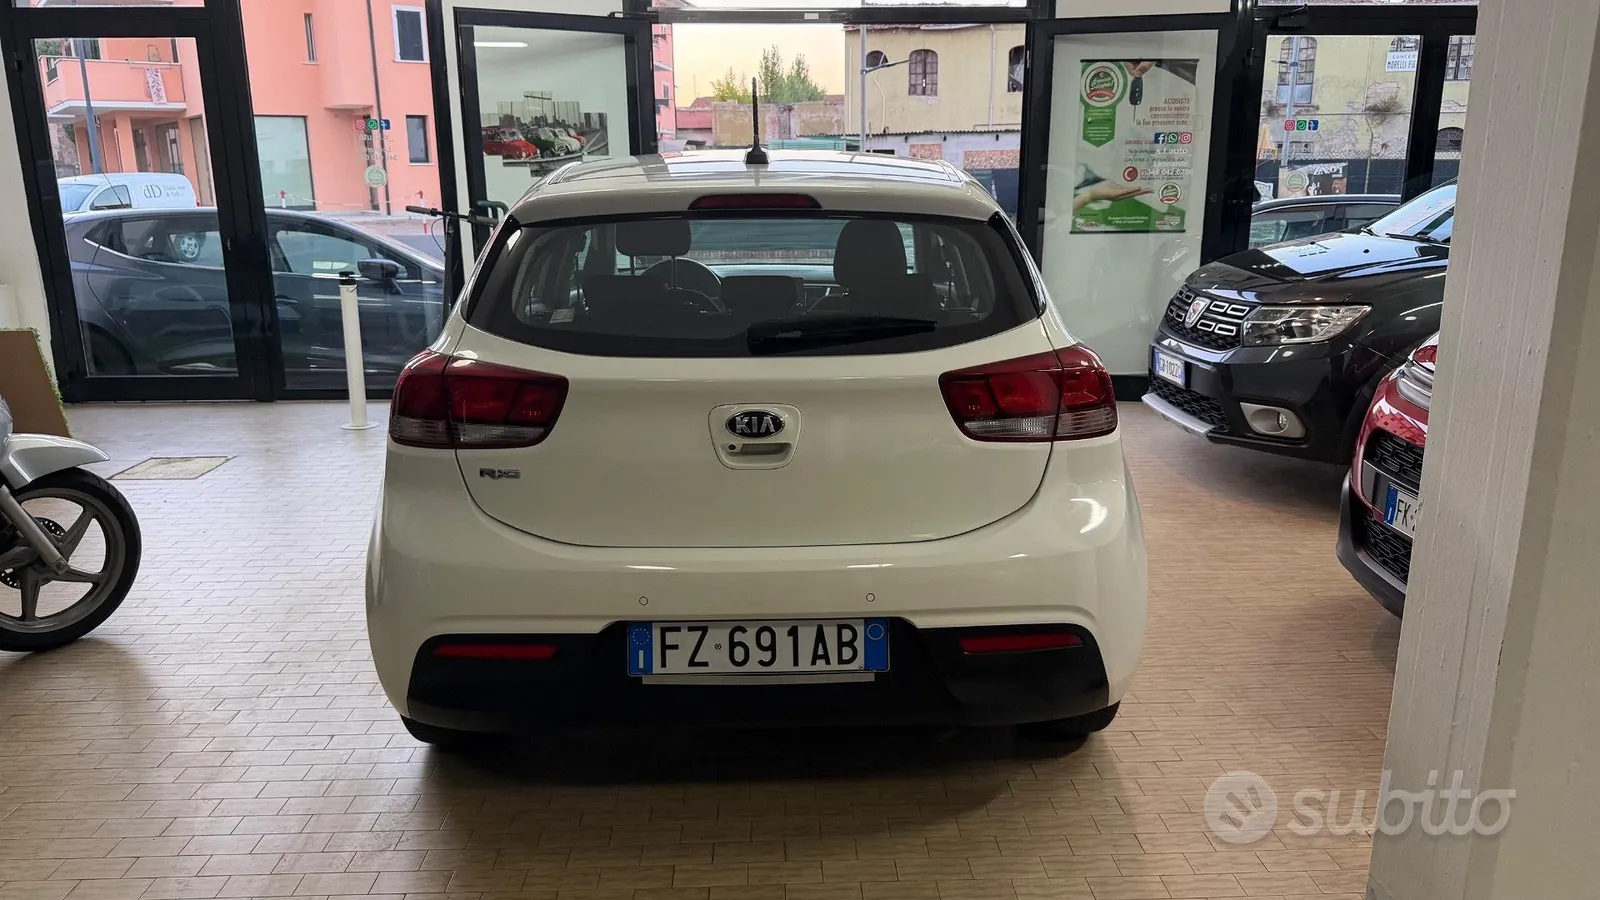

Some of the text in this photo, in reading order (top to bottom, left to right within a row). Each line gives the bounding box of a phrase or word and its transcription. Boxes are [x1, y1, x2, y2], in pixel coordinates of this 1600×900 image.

[735, 416, 776, 433] KIA
[659, 623, 859, 668] FZ 691AB
